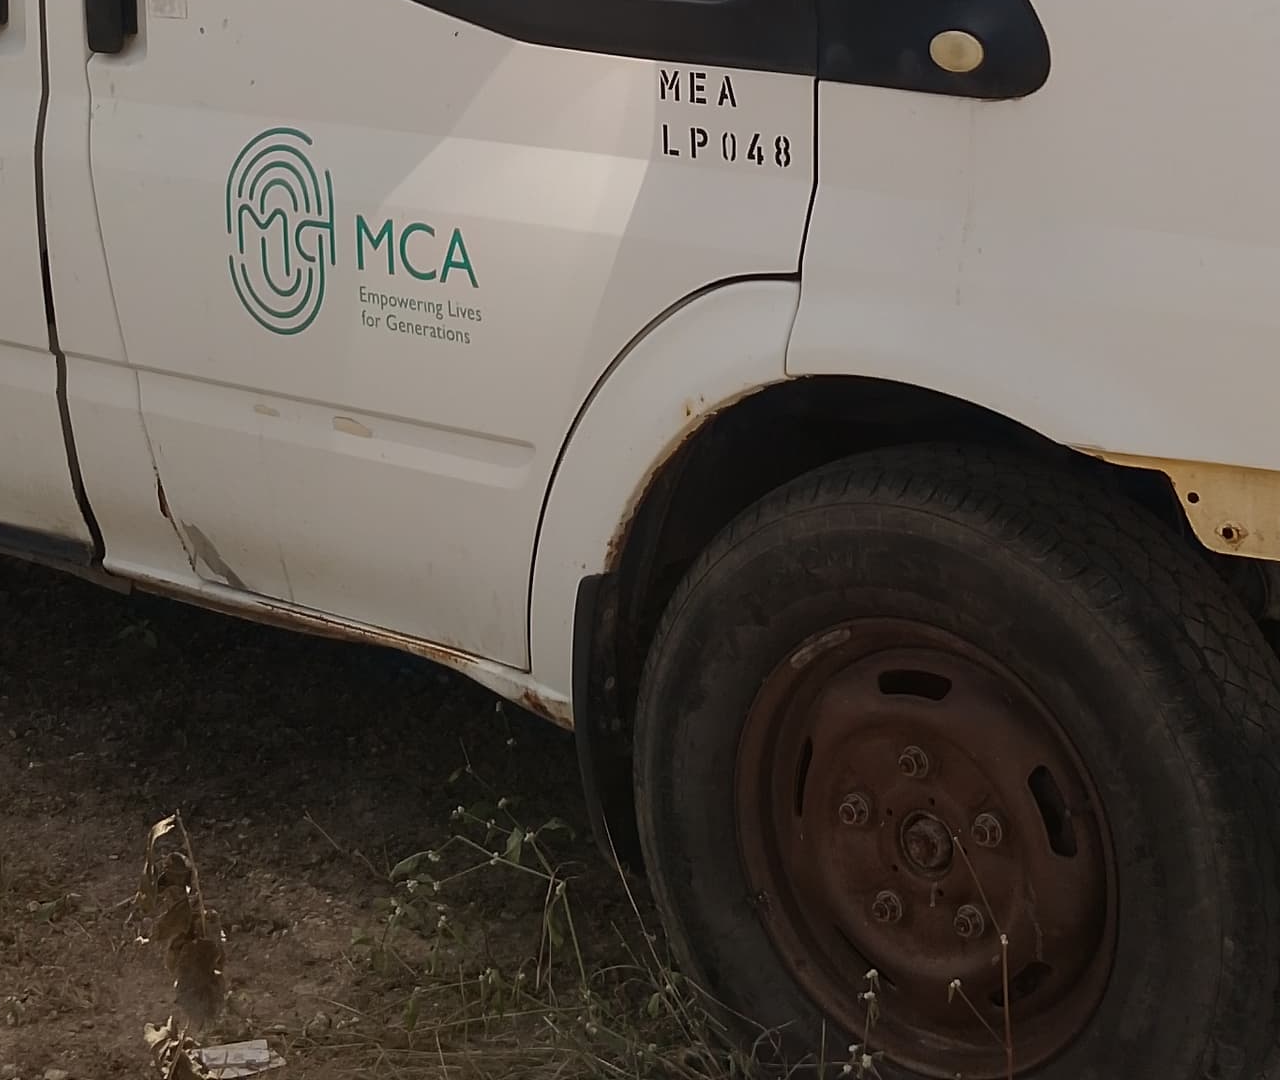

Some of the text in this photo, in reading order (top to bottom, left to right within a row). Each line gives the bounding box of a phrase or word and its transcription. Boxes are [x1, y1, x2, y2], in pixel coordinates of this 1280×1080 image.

[659, 69, 738, 108] MEA
[662, 123, 791, 168] LP048
[355, 214, 480, 289] MCA
[359, 285, 482, 322] Empowering Lives
[361, 309, 471, 345] for Generations
